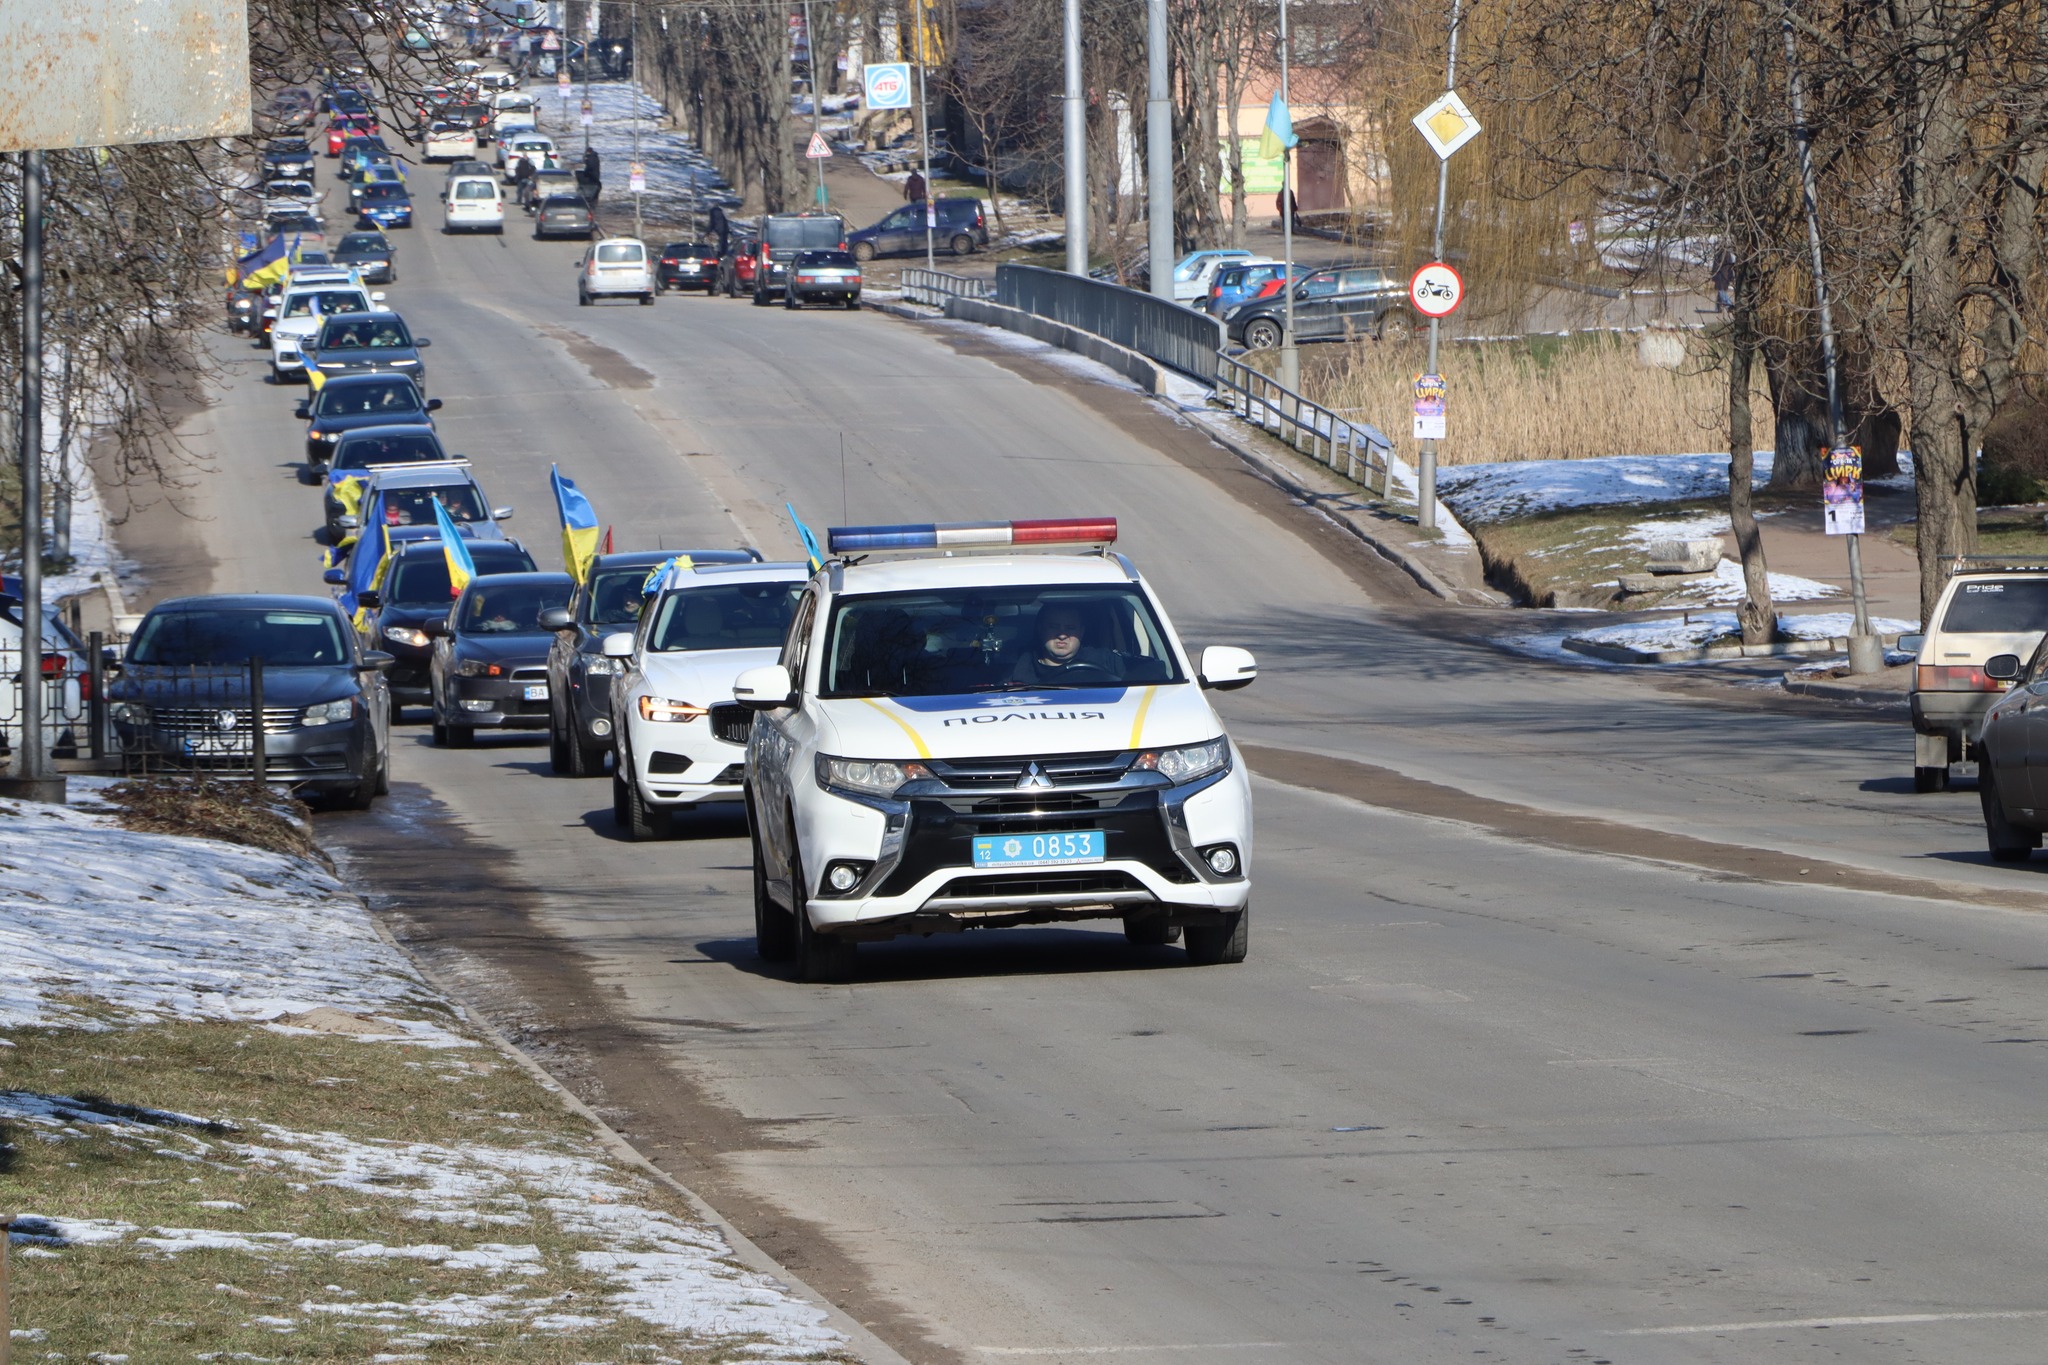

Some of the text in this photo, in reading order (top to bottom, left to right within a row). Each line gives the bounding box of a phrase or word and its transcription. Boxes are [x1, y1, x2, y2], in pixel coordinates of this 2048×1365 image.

[874, 81, 898, 91] АТБ
[1416, 420, 1423, 429] 1
[1825, 465, 1863, 482] ЦИРК
[1828, 510, 1836, 522] 1
[943, 711, 1105, 727] ПОЛІЦІЯ
[1032, 834, 1091, 858] 0853
[979, 850, 991, 860] 12
